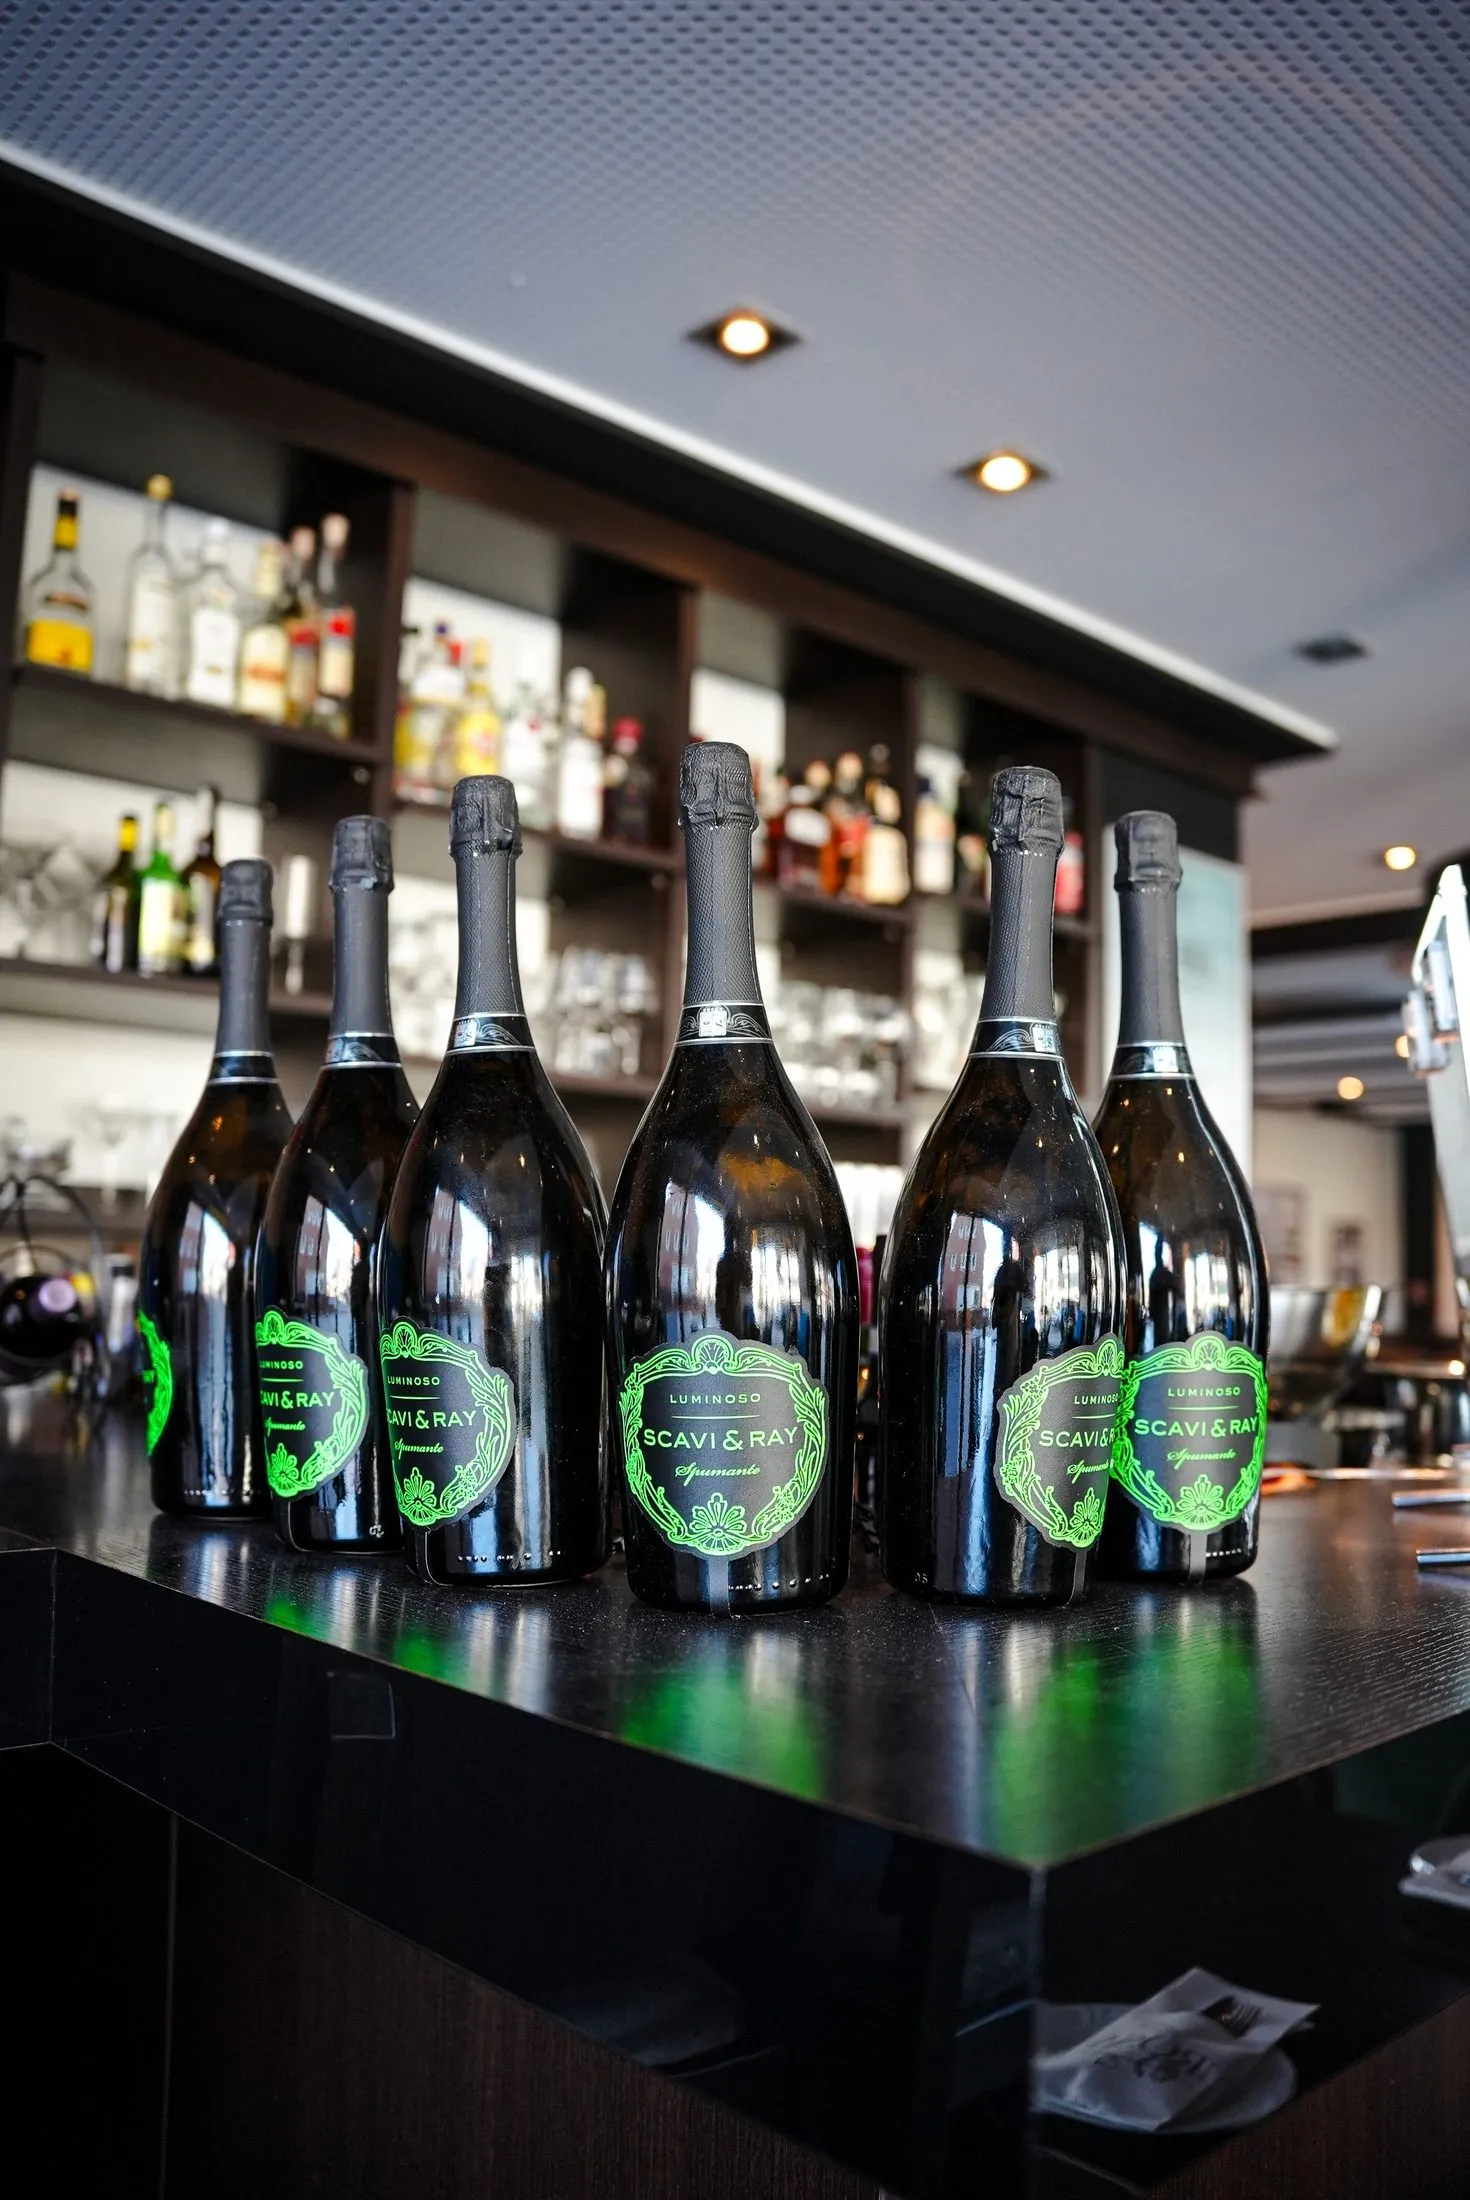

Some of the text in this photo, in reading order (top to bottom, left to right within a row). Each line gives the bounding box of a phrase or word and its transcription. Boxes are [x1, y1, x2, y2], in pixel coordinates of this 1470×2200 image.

[387, 1376, 440, 1386] LUMINOSO
[1167, 1386, 1241, 1397] LUMINOSO
[281, 1390, 294, 1409] &
[296, 1391, 335, 1408] RAY
[669, 1393, 761, 1404] LUMINOSO
[386, 1408, 477, 1429] CAVI & RAY
[1134, 1419, 1206, 1437] SCAVI
[1210, 1419, 1227, 1437] &
[1229, 1416, 1259, 1435] RAY
[643, 1426, 798, 1451] SCAVI & RAY
[1039, 1430, 1099, 1448] SCAVI
[1099, 1427, 1109, 1448] &
[394, 1438, 444, 1460] Spumante
[1166, 1447, 1237, 1470] Spumante
[674, 1461, 761, 1487] Spumante
